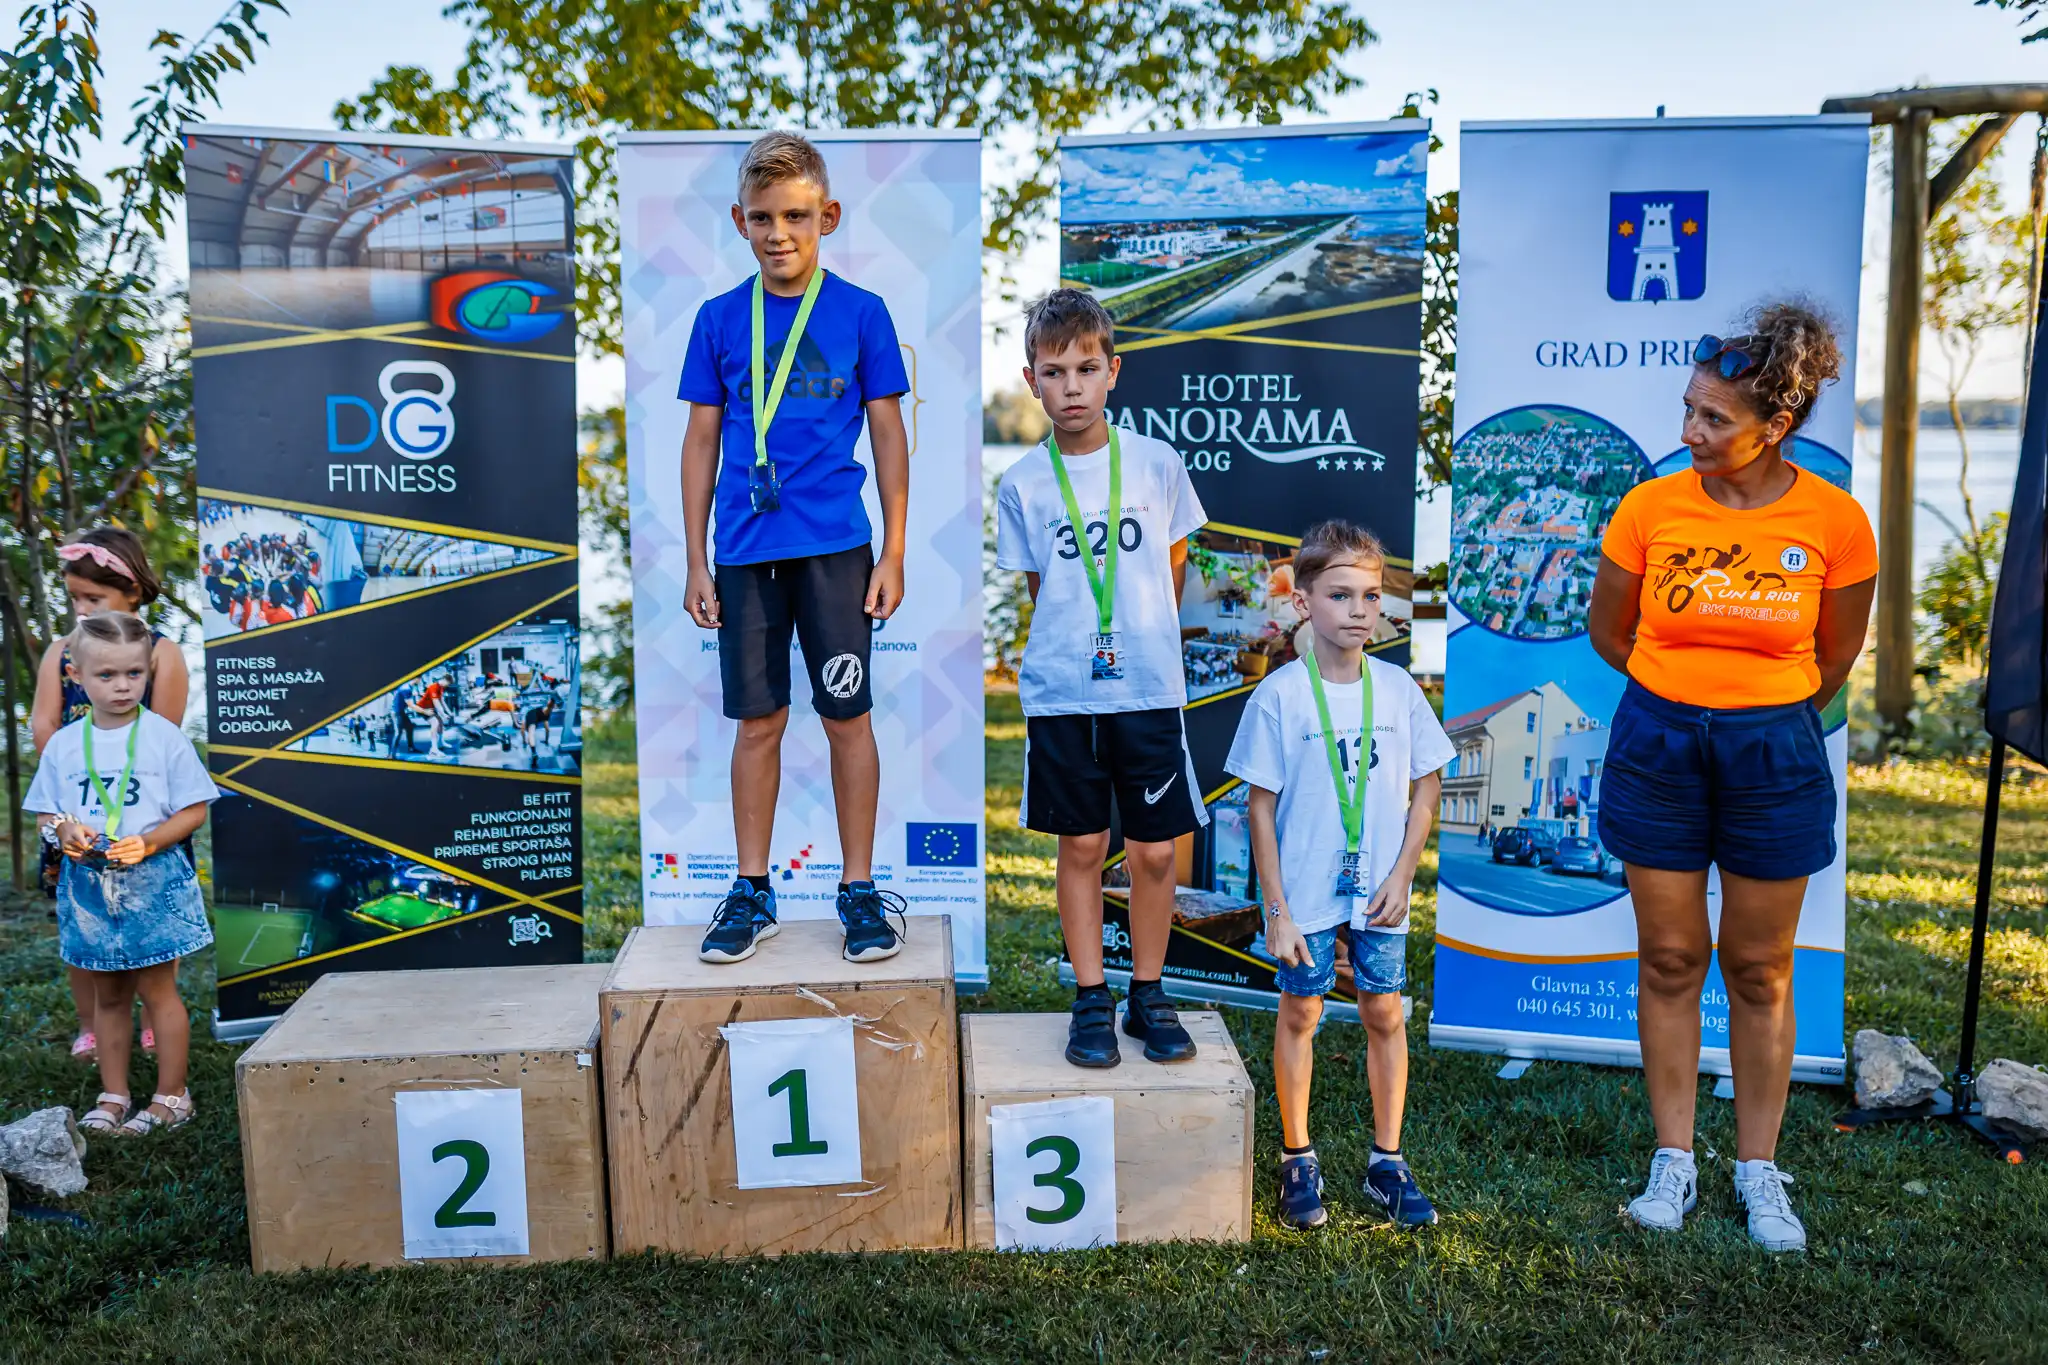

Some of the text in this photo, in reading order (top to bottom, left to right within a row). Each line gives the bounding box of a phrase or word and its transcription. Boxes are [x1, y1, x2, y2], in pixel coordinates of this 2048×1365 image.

[1535, 339, 1698, 368] GRAD PRE
[737, 371, 845, 403] adas
[1181, 374, 1301, 401] HOTEL
[1180, 450, 1231, 472] LOG
[328, 463, 457, 493] FITNESS
[1056, 517, 1142, 560] 320
[1765, 590, 1801, 603] RIDE
[1698, 601, 1800, 623] BK PRELOG
[216, 656, 276, 670] FITNESS
[216, 667, 325, 687] SPA & MASAŽA
[217, 688, 289, 702] RUKOMET
[218, 705, 275, 718] FUTSAL
[218, 719, 293, 734] ODBOJKA
[523, 792, 572, 806] BE FITT
[471, 807, 572, 825] FUNKCIONALNI
[454, 822, 572, 841] REHABILITACIJSKI
[434, 835, 572, 859] PRIPREME SPORTAŠA
[482, 852, 572, 870] STRONG MAN
[521, 866, 572, 881] PILATES
[1531, 975, 1590, 996] Glavna
[1595, 979, 1621, 999] 35,
[1516, 996, 1548, 1015] 040
[1551, 1000, 1582, 1018] 645
[1586, 1003, 1622, 1021] 301,
[767, 1068, 829, 1157] 1
[431, 1138, 497, 1229] 2
[1024, 1134, 1086, 1225] 3
